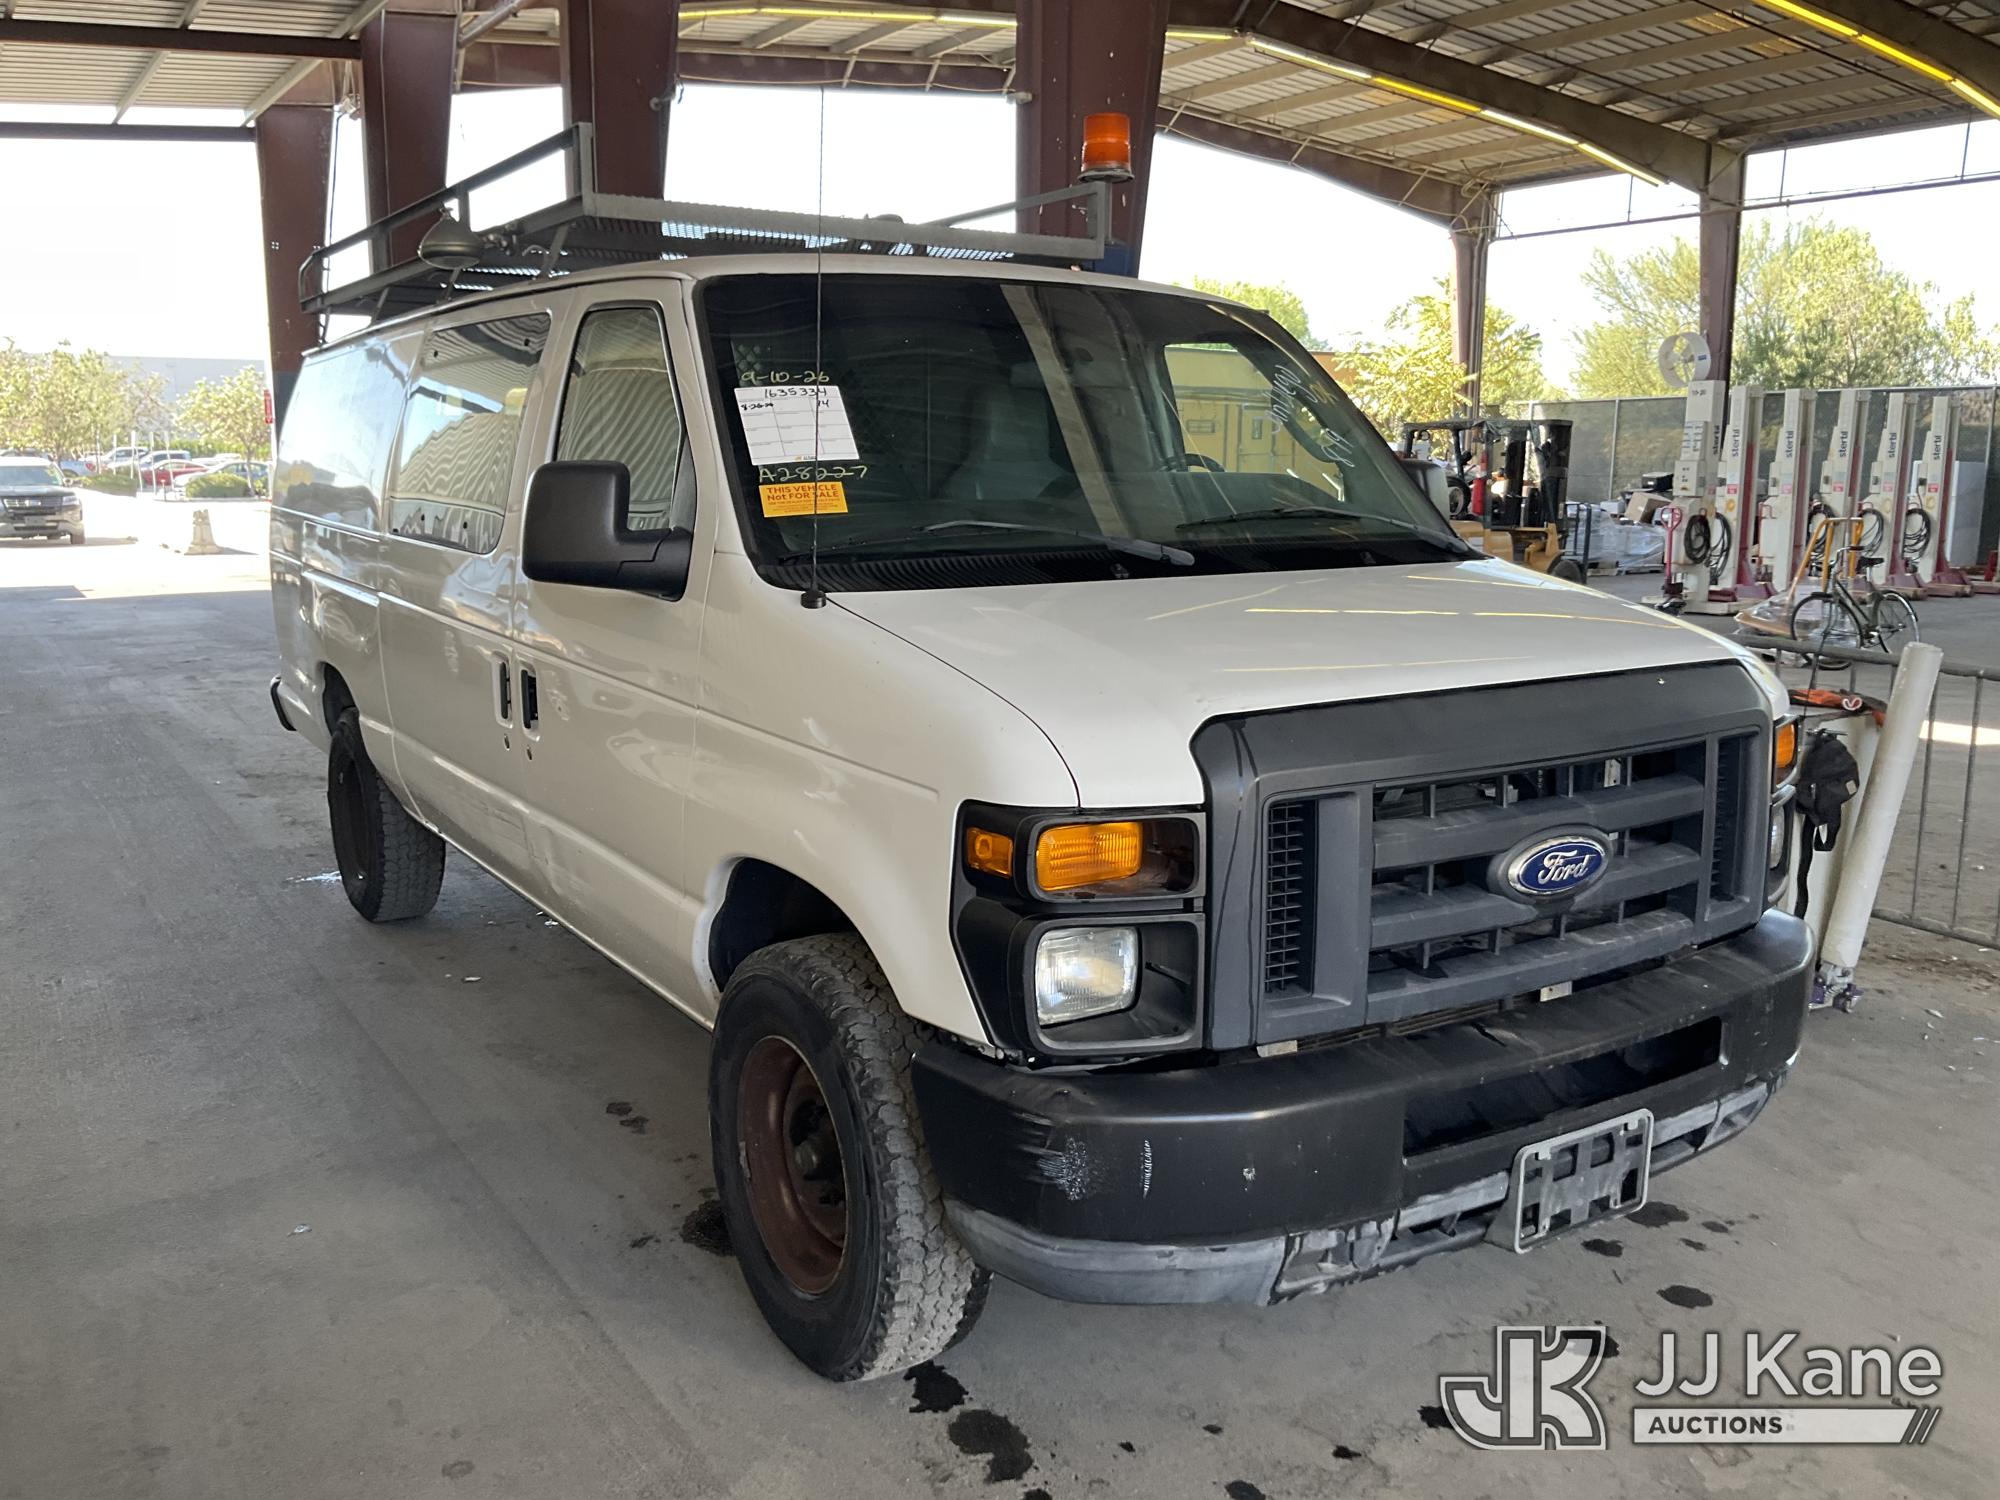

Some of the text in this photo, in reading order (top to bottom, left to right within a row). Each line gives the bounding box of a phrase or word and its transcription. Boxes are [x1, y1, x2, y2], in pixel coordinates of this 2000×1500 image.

[767, 486, 791, 494] THIS
[789, 492, 810, 500] FOR
[1538, 850, 1598, 884] Ford
